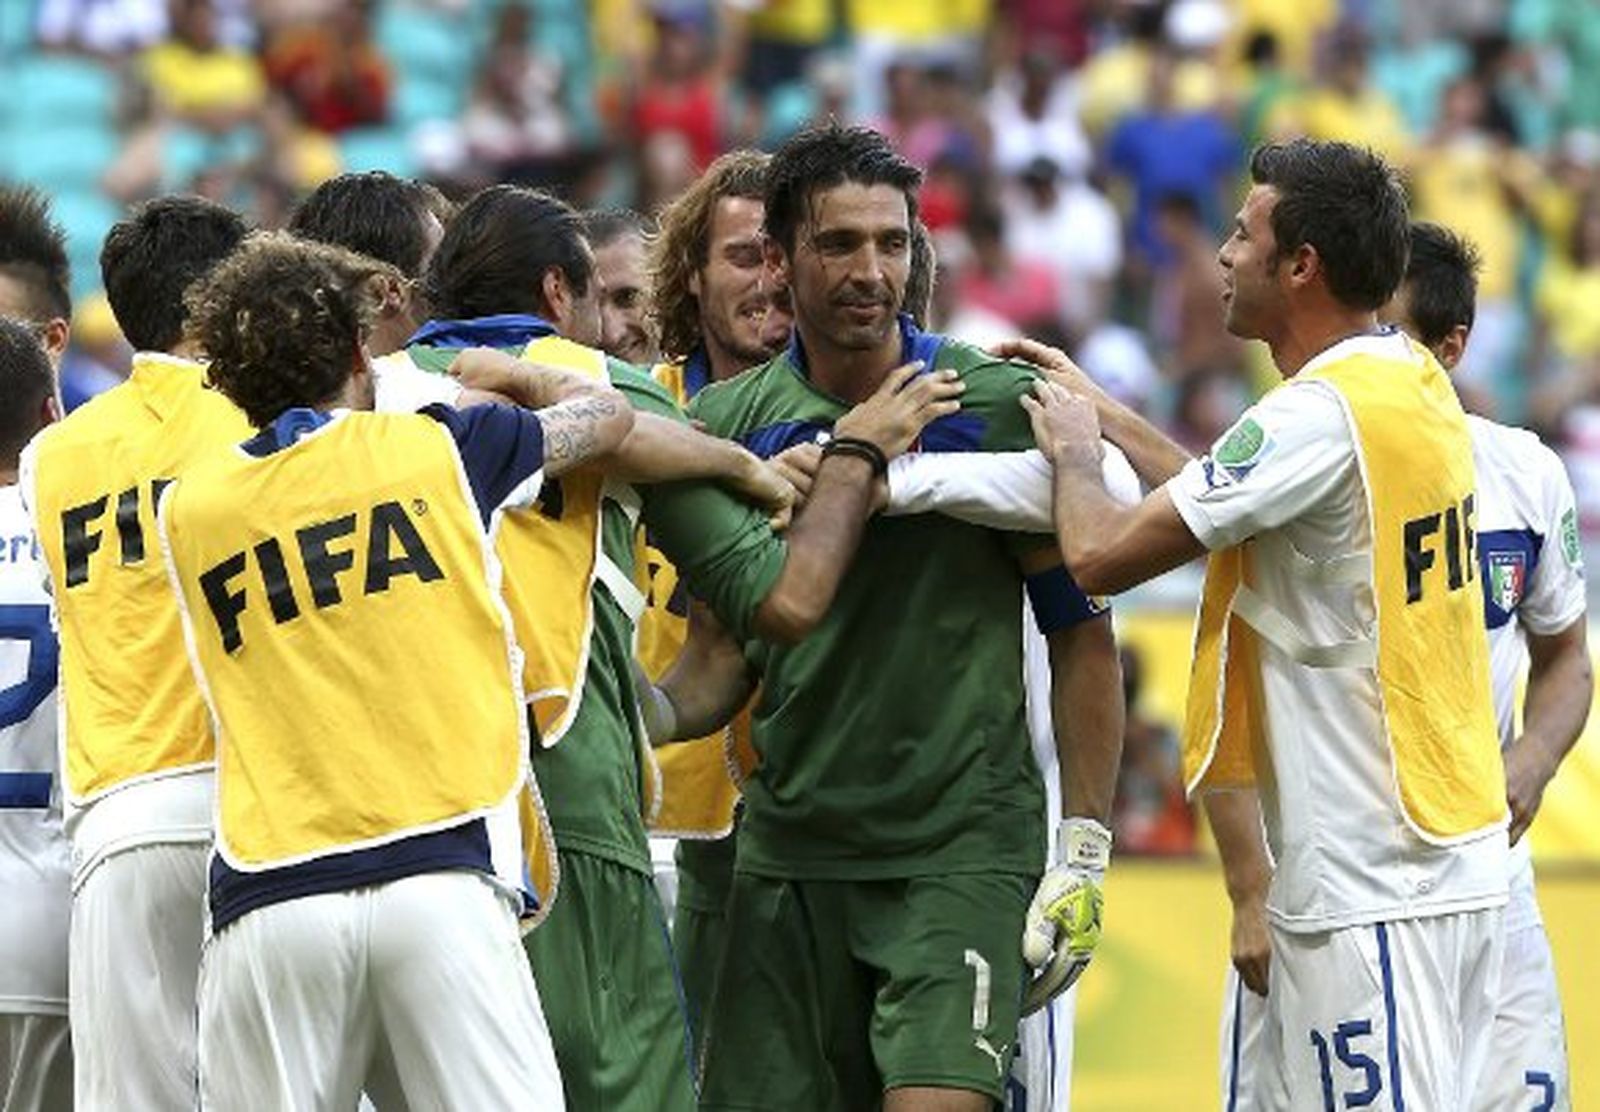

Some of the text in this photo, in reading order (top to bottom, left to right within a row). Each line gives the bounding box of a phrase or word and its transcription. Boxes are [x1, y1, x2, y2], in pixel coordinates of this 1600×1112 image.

[61, 477, 176, 588] FI
[964, 949, 991, 1029] 1
[1310, 1019, 1382, 1112] 15
